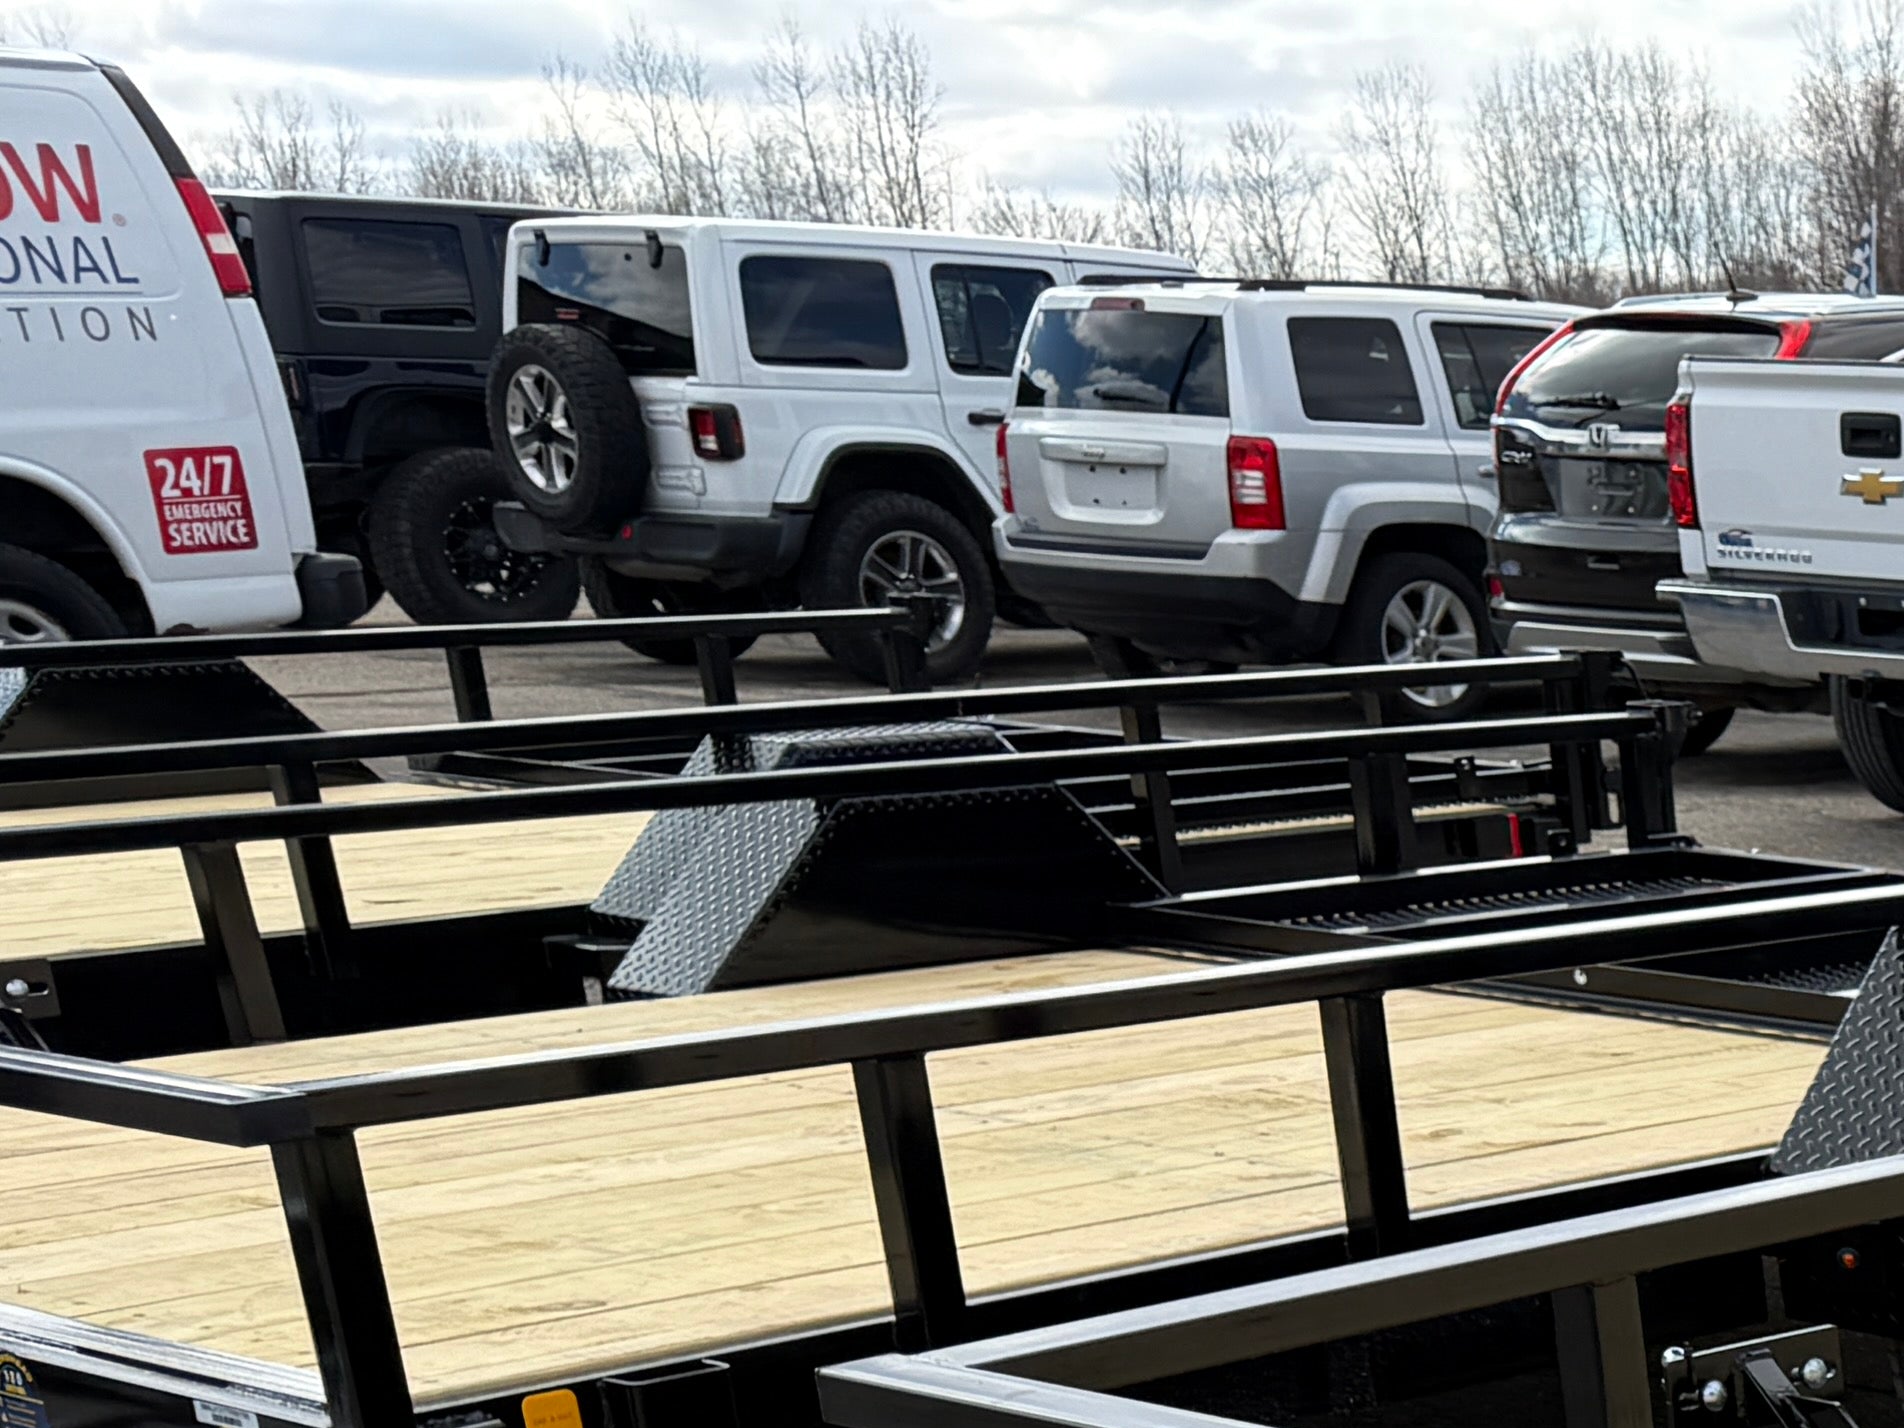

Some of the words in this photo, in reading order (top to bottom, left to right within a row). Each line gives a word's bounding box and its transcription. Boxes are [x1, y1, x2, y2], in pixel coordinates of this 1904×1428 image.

[154, 455, 232, 498] 24/7
[163, 501, 242, 521] EMERGENCY
[168, 519, 250, 547] SERVICE
[1717, 544, 1812, 564] SILVERADO
